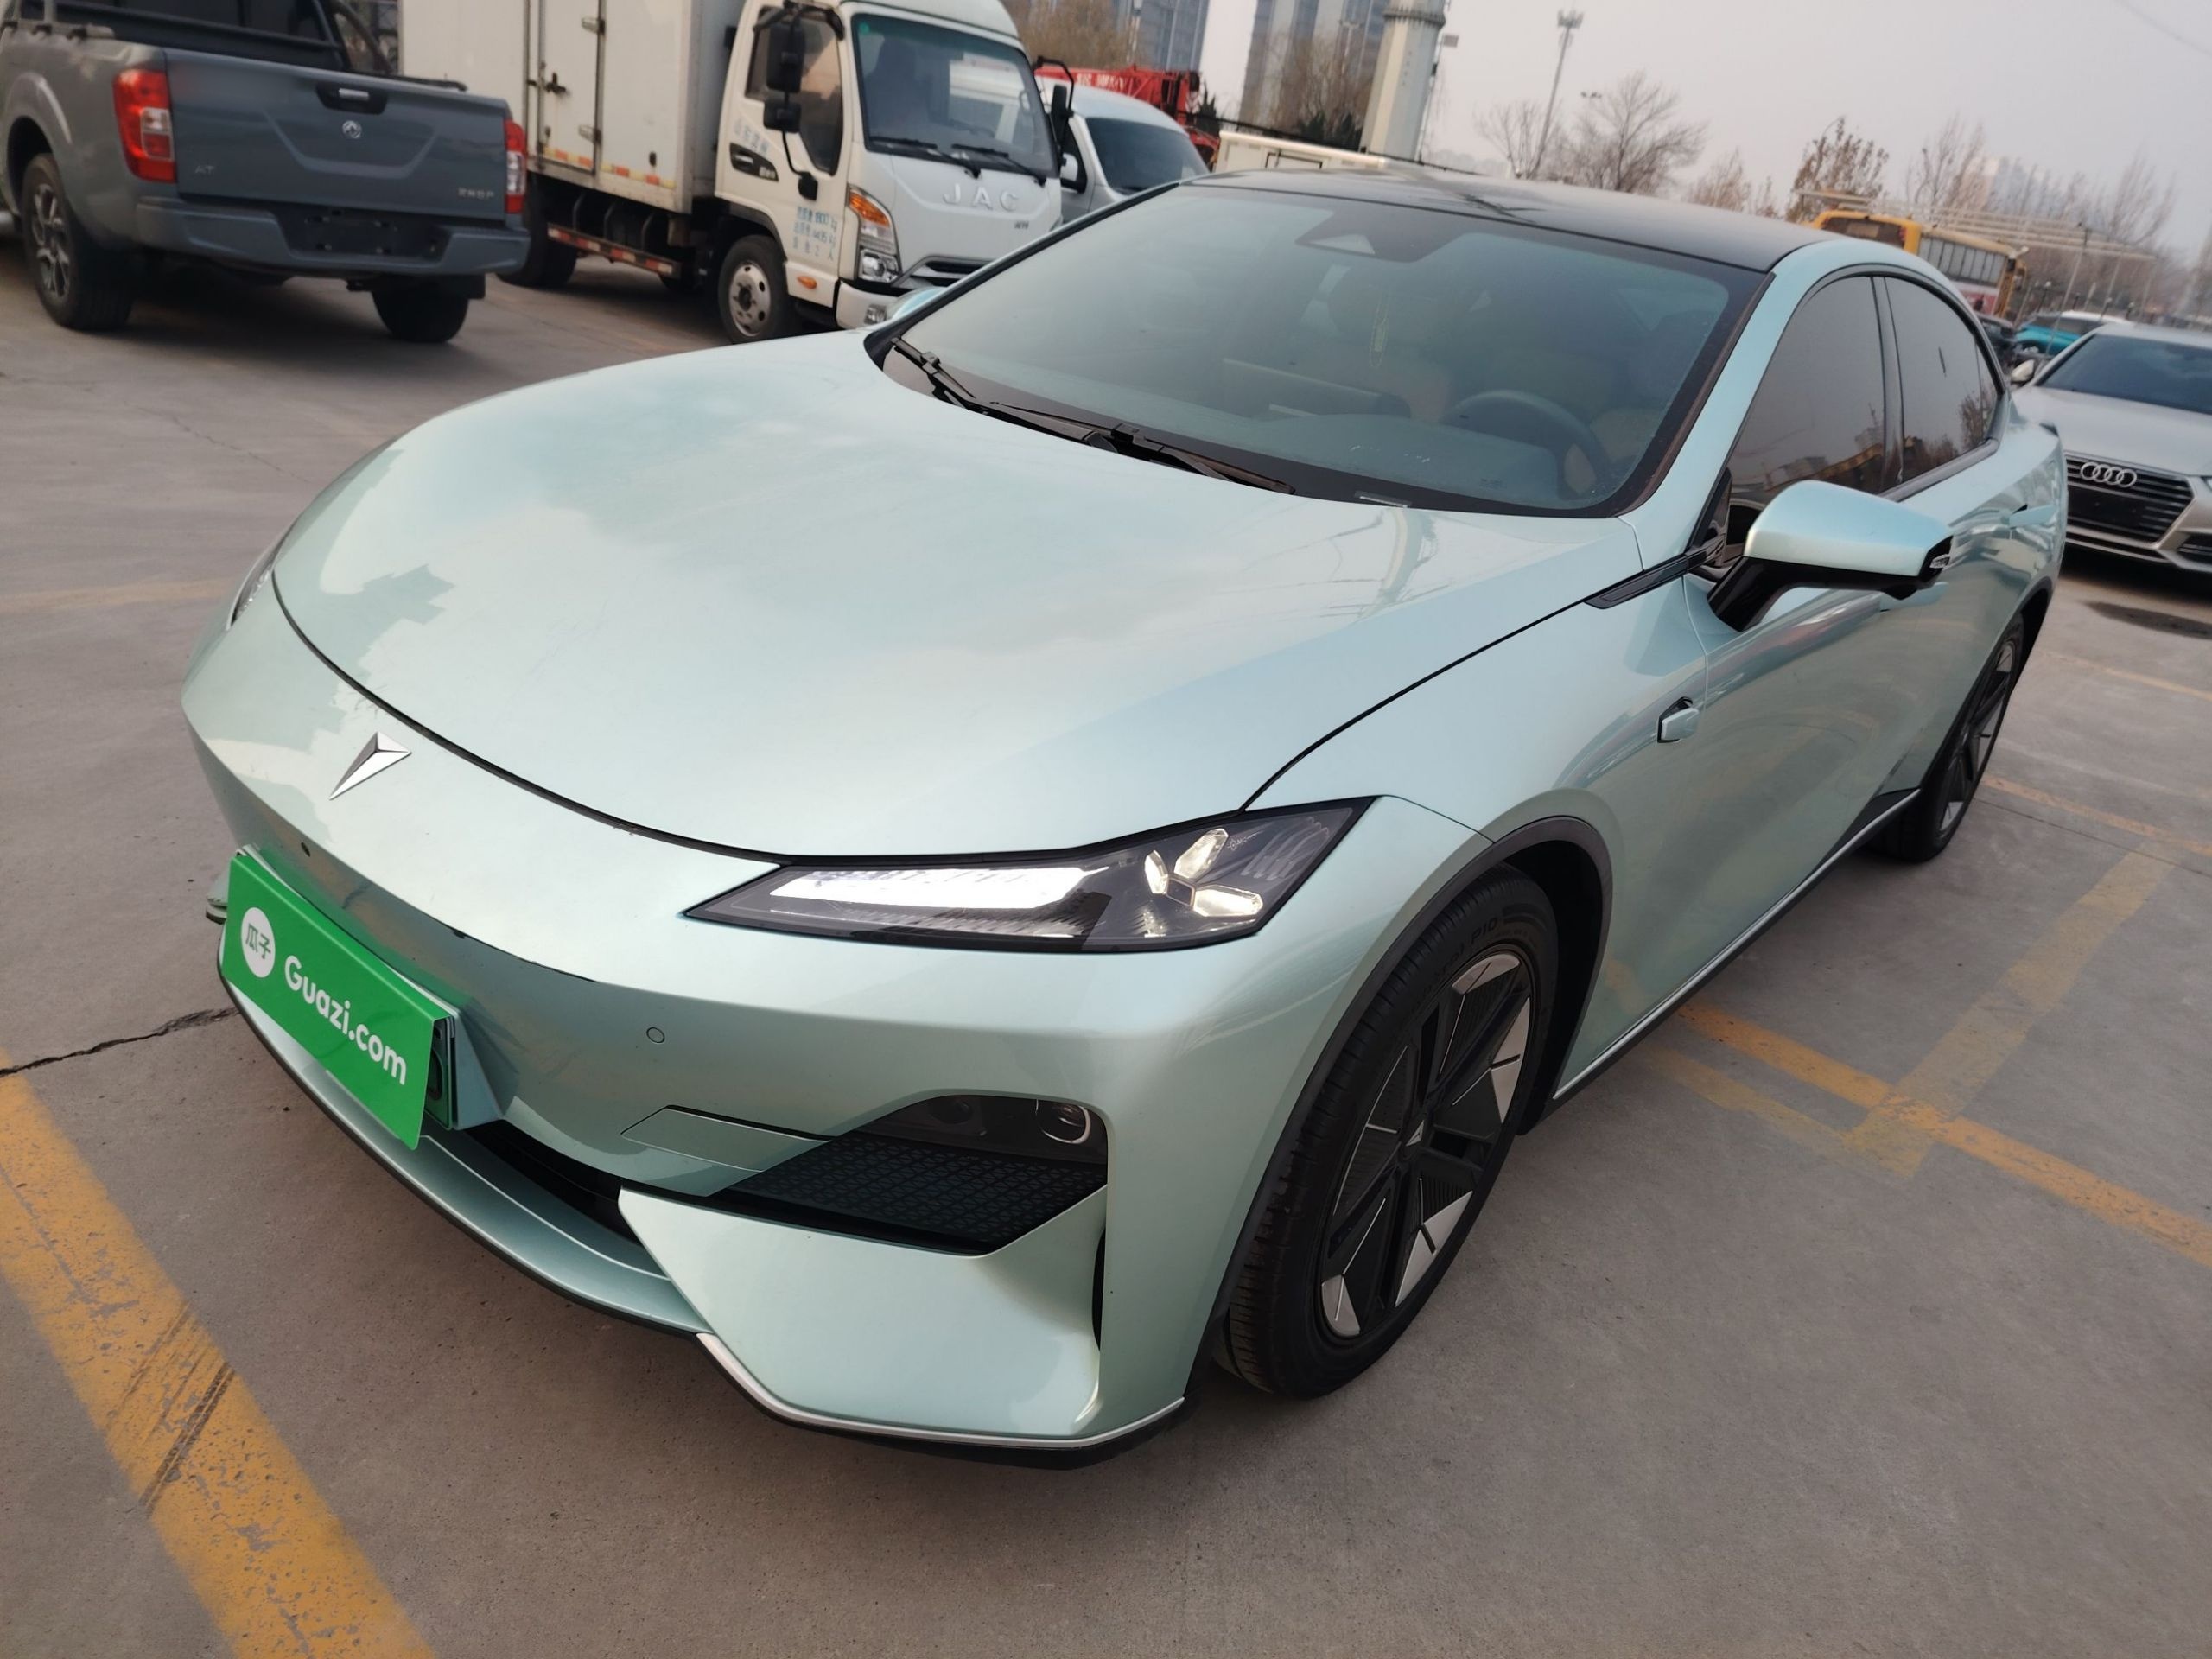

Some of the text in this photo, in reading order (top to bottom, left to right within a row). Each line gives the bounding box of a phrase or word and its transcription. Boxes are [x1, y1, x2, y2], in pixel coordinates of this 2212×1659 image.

[943, 183, 1020, 212] JAC
[245, 923, 271, 959] 瓜子
[284, 955, 407, 1085] Guazi.com
